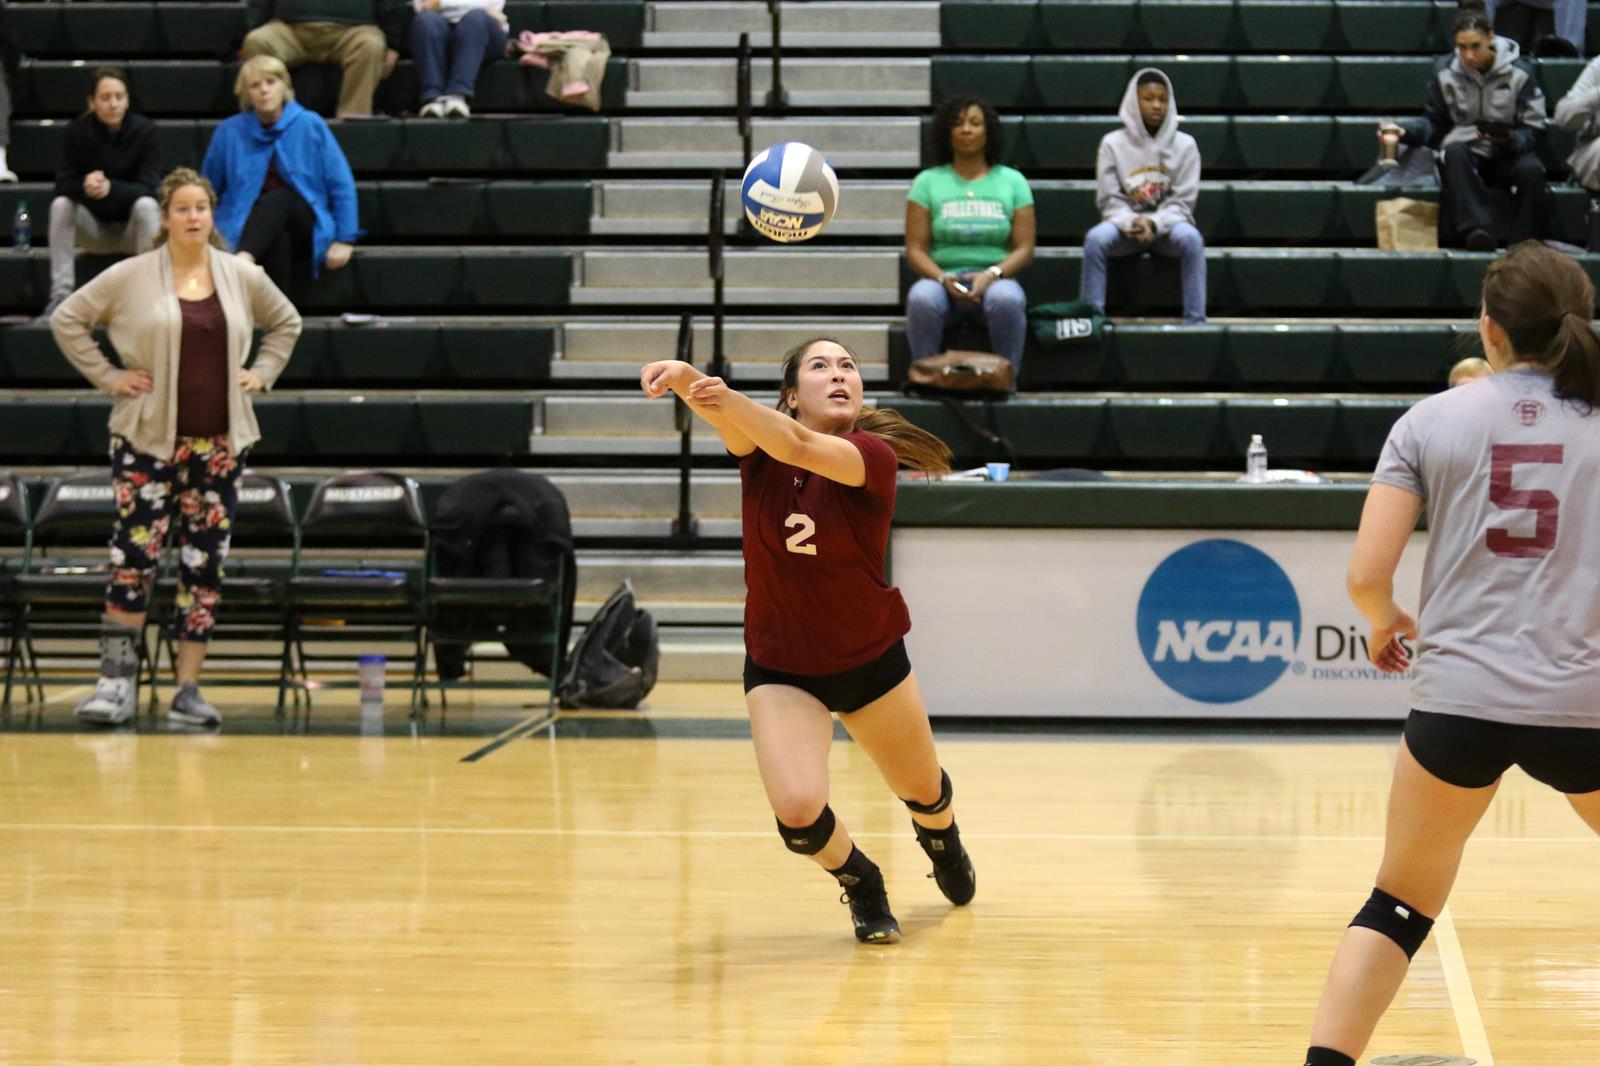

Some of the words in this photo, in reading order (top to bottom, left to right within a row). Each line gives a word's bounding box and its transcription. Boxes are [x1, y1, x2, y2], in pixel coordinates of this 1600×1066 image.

[759, 208, 804, 229] NCAA
[326, 486, 403, 501] MUSTANGS
[1486, 444, 1564, 558] 5
[784, 513, 817, 556] 2
[1154, 620, 1297, 662] NCAA
